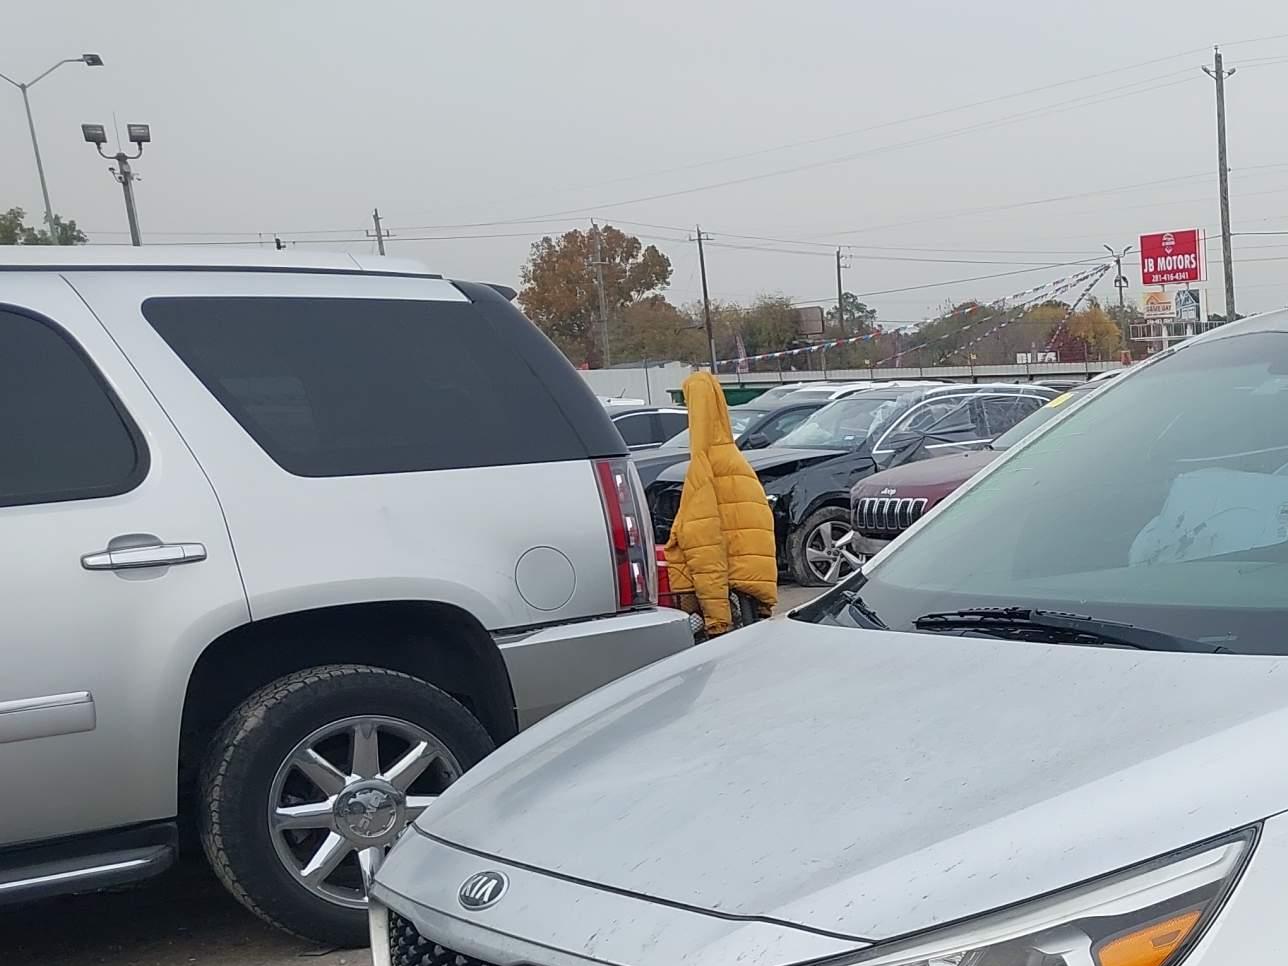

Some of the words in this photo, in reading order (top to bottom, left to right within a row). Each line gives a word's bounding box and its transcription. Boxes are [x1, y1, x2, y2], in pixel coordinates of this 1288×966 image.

[1143, 258, 1155, 273] JB
[1157, 253, 1197, 272] MOTORS
[880, 487, 897, 497] Jeep
[460, 875, 498, 902] KIA
